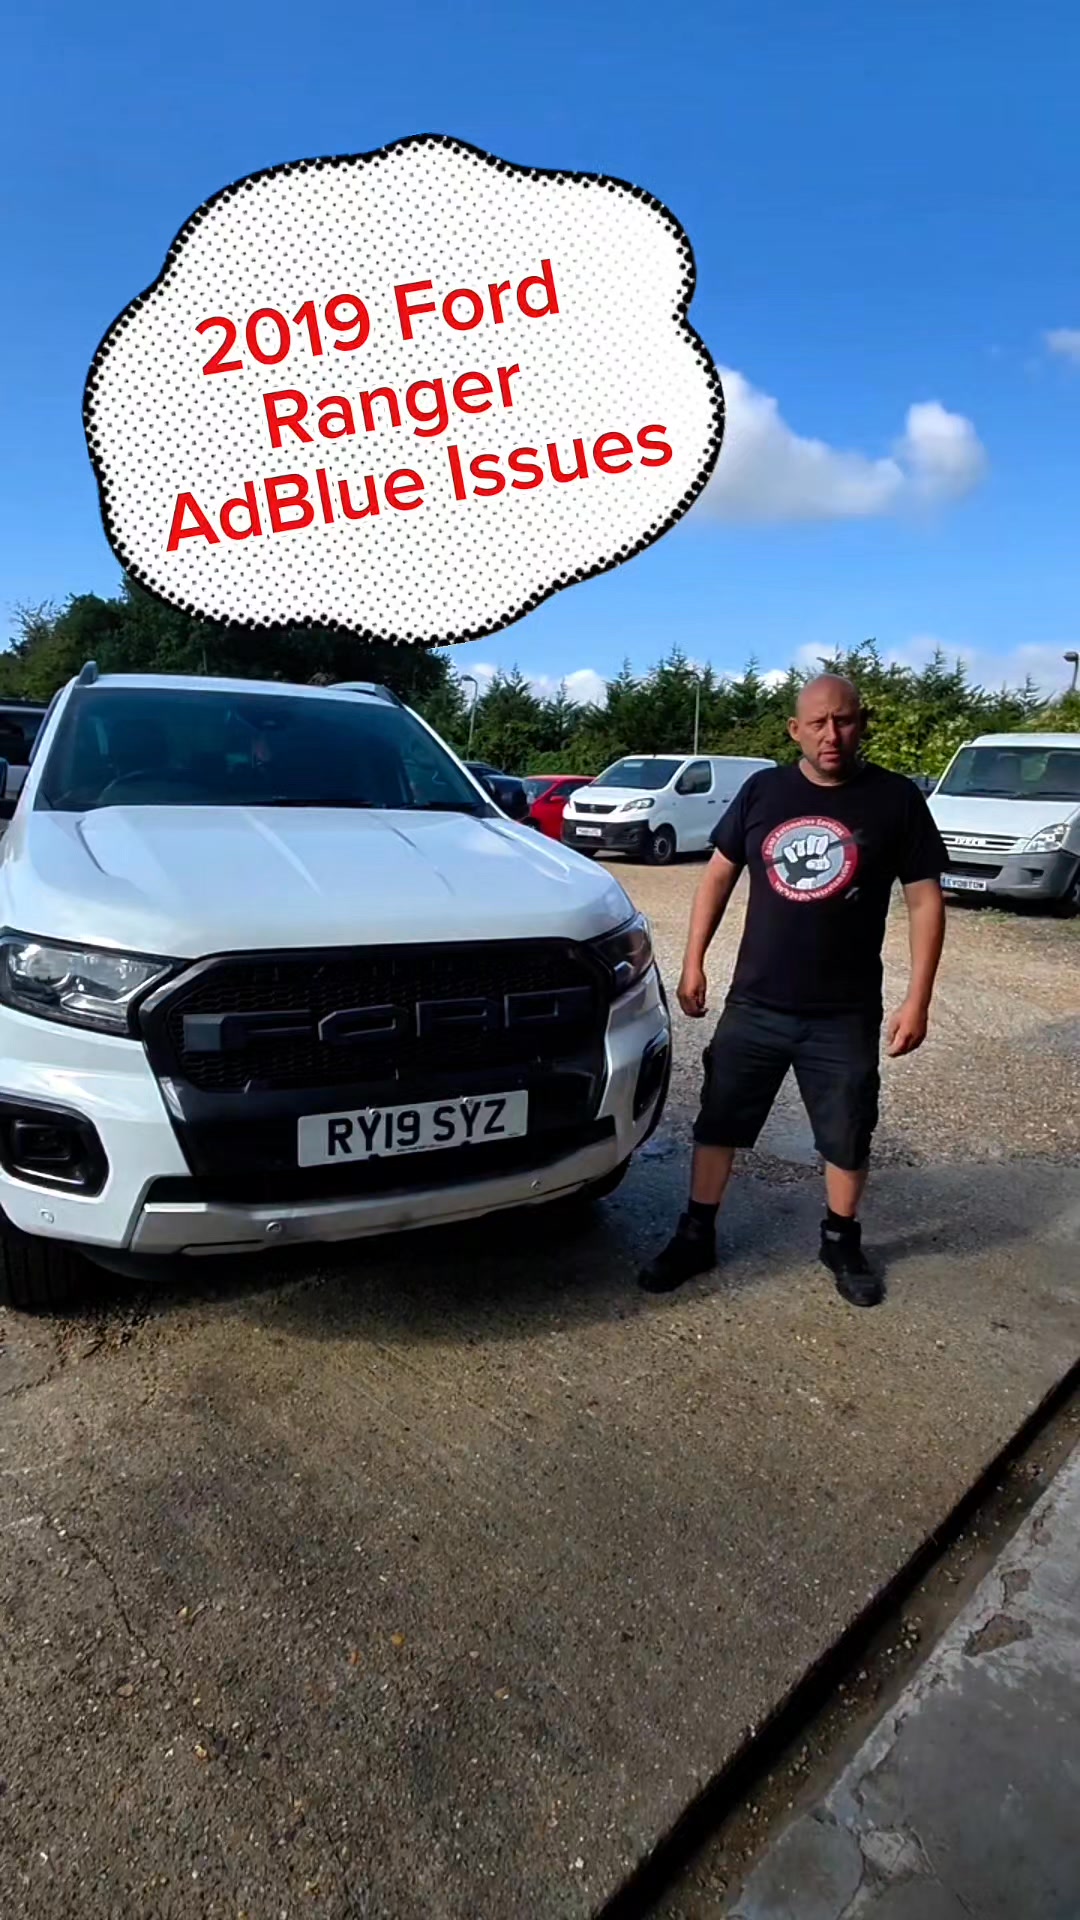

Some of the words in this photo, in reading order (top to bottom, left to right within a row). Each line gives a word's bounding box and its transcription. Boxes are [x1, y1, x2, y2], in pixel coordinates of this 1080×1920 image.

[183, 986, 594, 1053] FORD
[327, 1110, 421, 1156] RY19
[433, 1098, 506, 1141] SYZ
